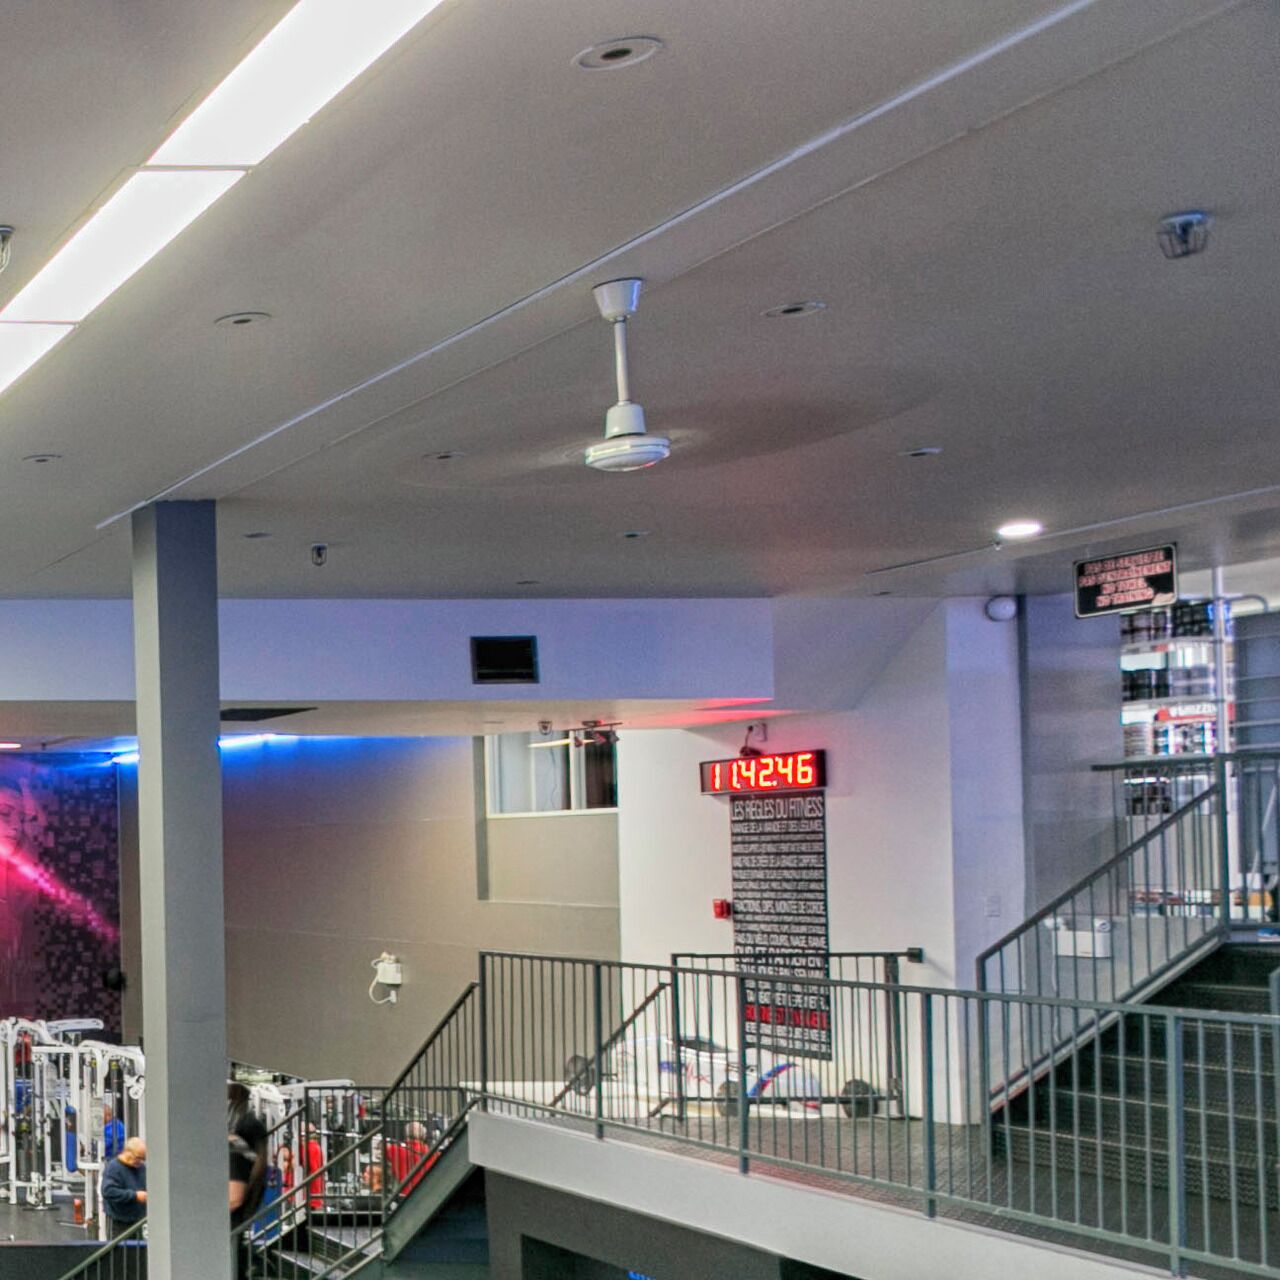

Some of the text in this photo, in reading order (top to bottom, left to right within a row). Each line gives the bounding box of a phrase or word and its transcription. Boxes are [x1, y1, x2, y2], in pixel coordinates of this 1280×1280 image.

[731, 796, 824, 820] LES RÈGLES DU FITNESS
